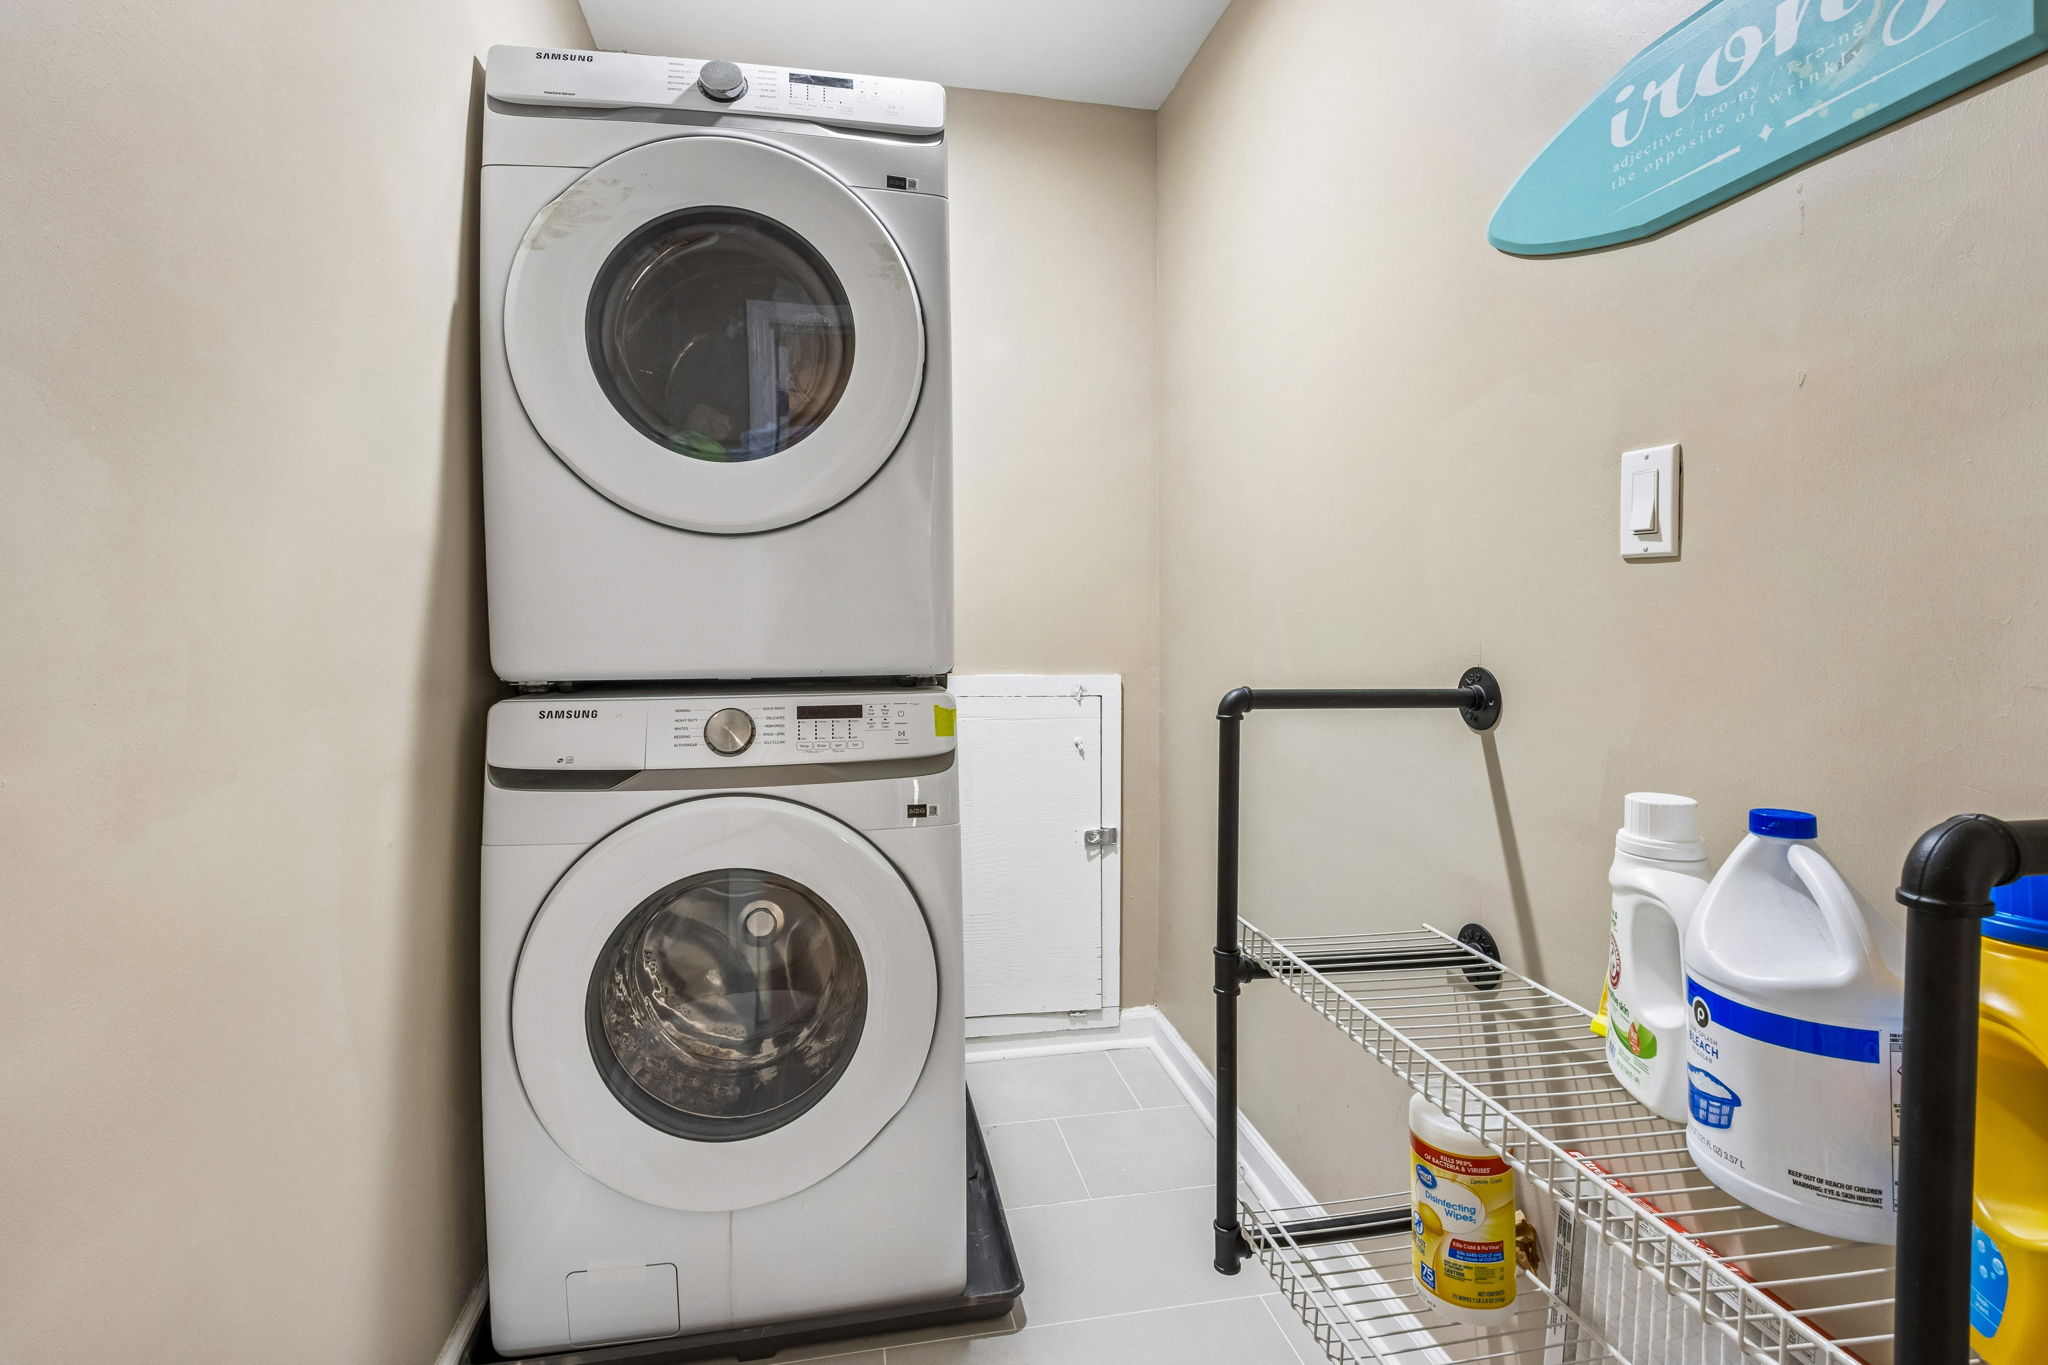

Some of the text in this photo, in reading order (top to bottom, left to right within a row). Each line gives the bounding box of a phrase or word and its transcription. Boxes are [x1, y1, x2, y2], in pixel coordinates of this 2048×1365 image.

[536, 52, 593, 62] SAMSUNG
[1612, 127, 1683, 173] adjective
[1704, 83, 1760, 121] iro-ny
[1611, 171, 1636, 190] the
[1644, 123, 1725, 174] opposite
[1735, 101, 1758, 123] of
[539, 710, 598, 719] SAMSUNG
[1689, 1030, 1719, 1059] BLEACH
[1431, 1157, 1460, 1172] BACTERIA
[1440, 1155, 1454, 1164] KILLS
[1724, 1151, 1739, 1165] 3.57
[1740, 1160, 1746, 1170] L
[1788, 1169, 1883, 1195] KEEP OUT OF REACH OF CHILDREN
[1792, 1179, 1823, 1193] WARNING:
[1824, 1188, 1835, 1196] EYE
[1841, 1192, 1856, 1200] SKIN
[1856, 1195, 1883, 1204] IRRITANT
[1425, 1190, 1477, 1216] Disinfecting
[1422, 1262, 1434, 1281] 75
[1444, 1267, 1465, 1277] CAUTION
